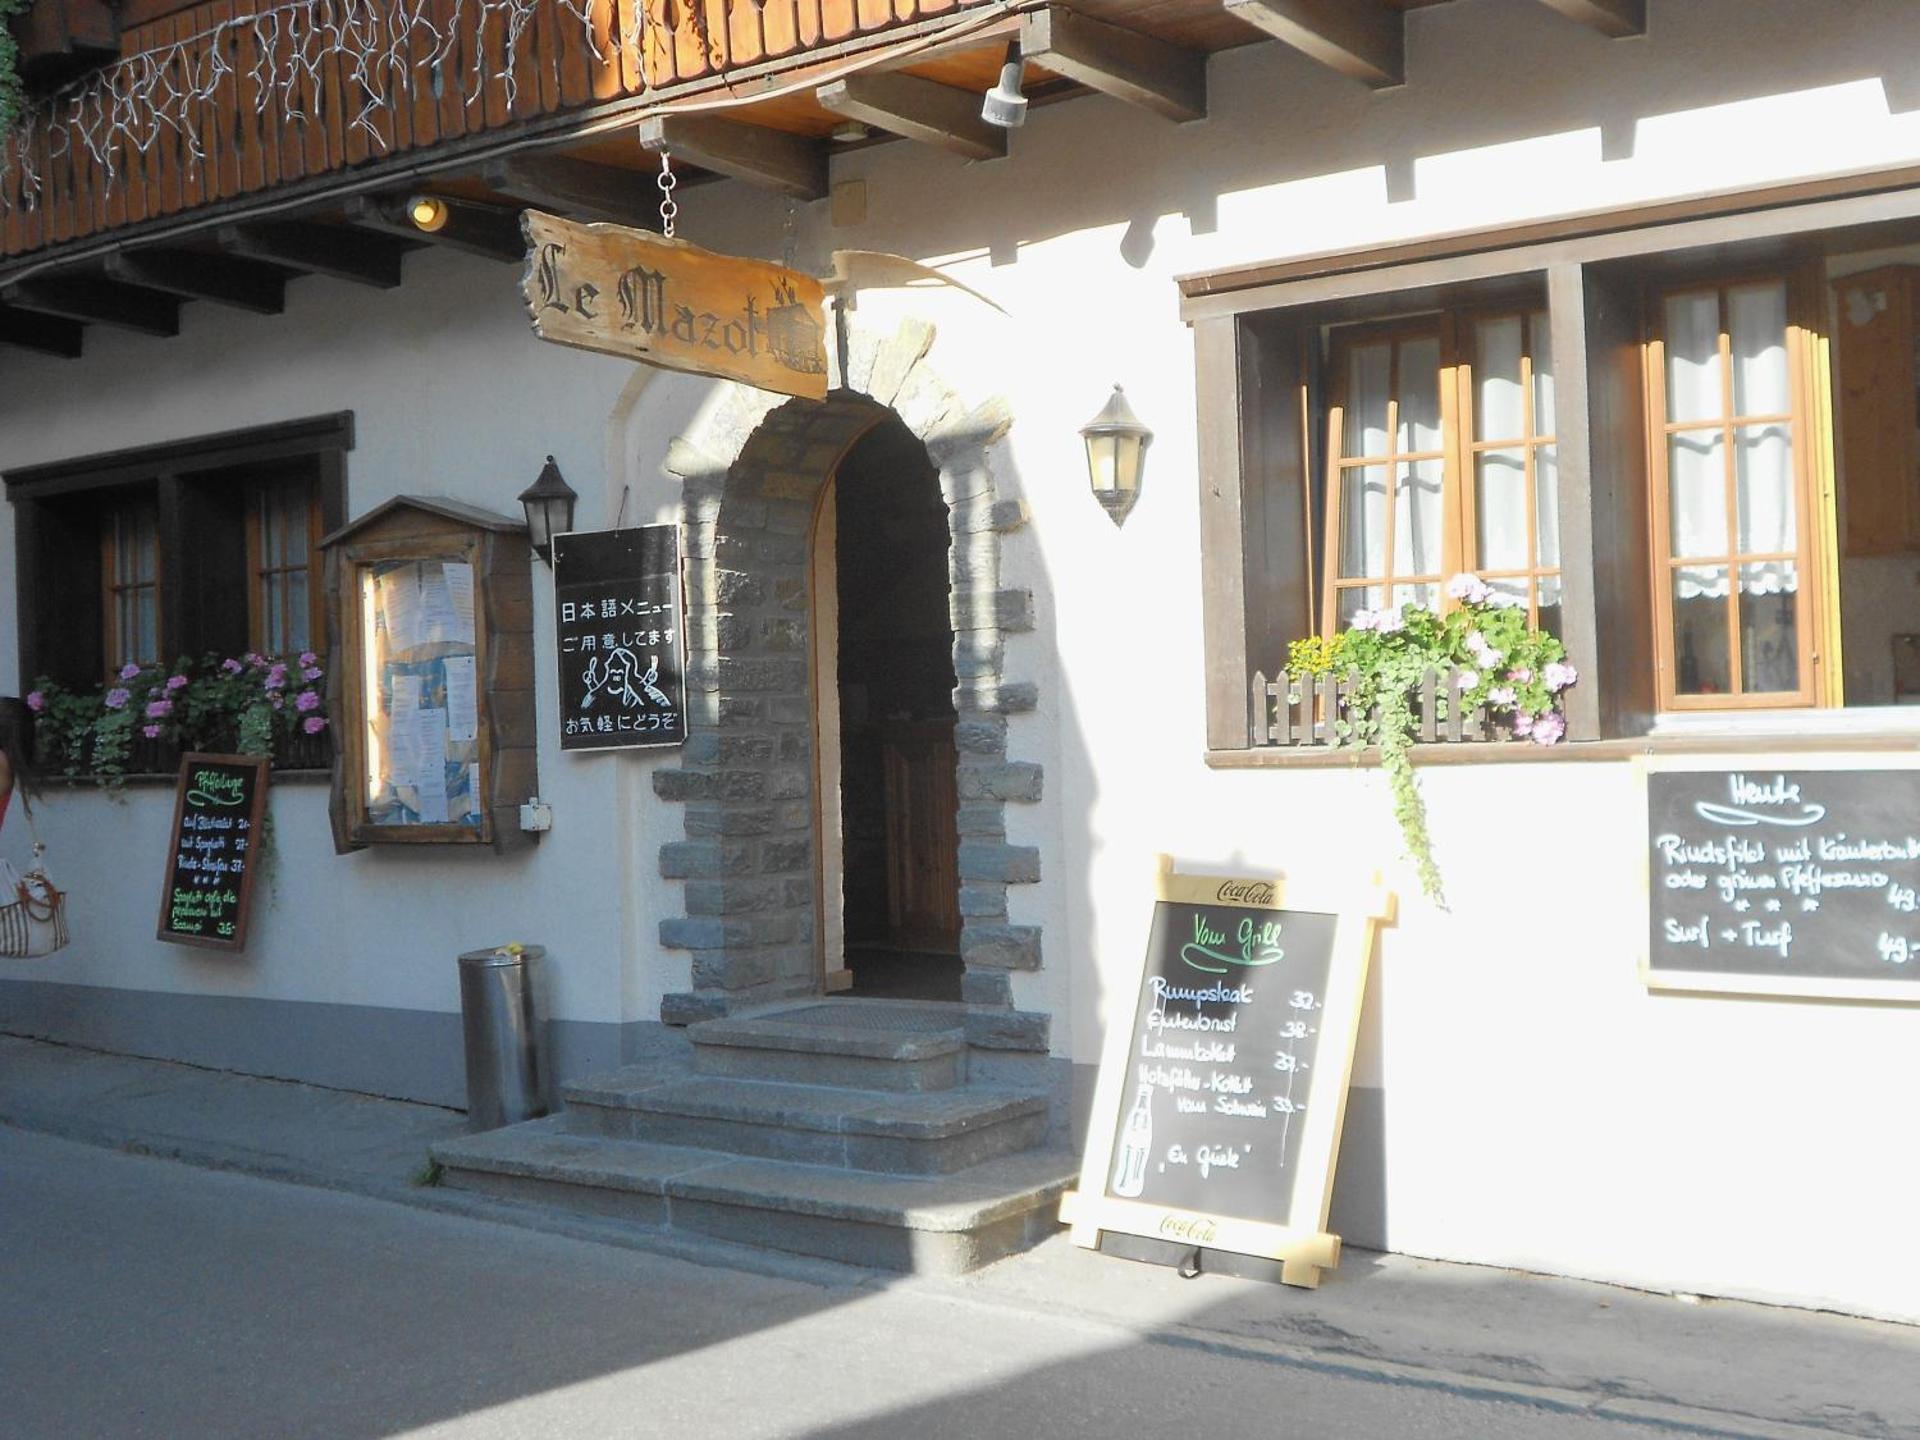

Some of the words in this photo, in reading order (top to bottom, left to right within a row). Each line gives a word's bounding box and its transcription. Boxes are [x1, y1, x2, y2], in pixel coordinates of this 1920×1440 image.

[539, 244, 600, 319] Le
[618, 265, 759, 358] Mazot
[562, 598, 674, 623] 日本語メニュー
[563, 629, 675, 652] ご用意してます
[565, 711, 677, 735] お気軽にどうぞ
[1729, 773, 1801, 805] Heute
[1777, 837, 1811, 863] mit
[1665, 868, 1708, 889] oder
[1216, 879, 1275, 905] Coca-Cola
[1194, 913, 1226, 945] Vom
[1238, 918, 1282, 961] Grill
[1664, 915, 1710, 949] Surf
[1742, 920, 1793, 958] Turf
[1149, 975, 1254, 1010] Rumpsteak
